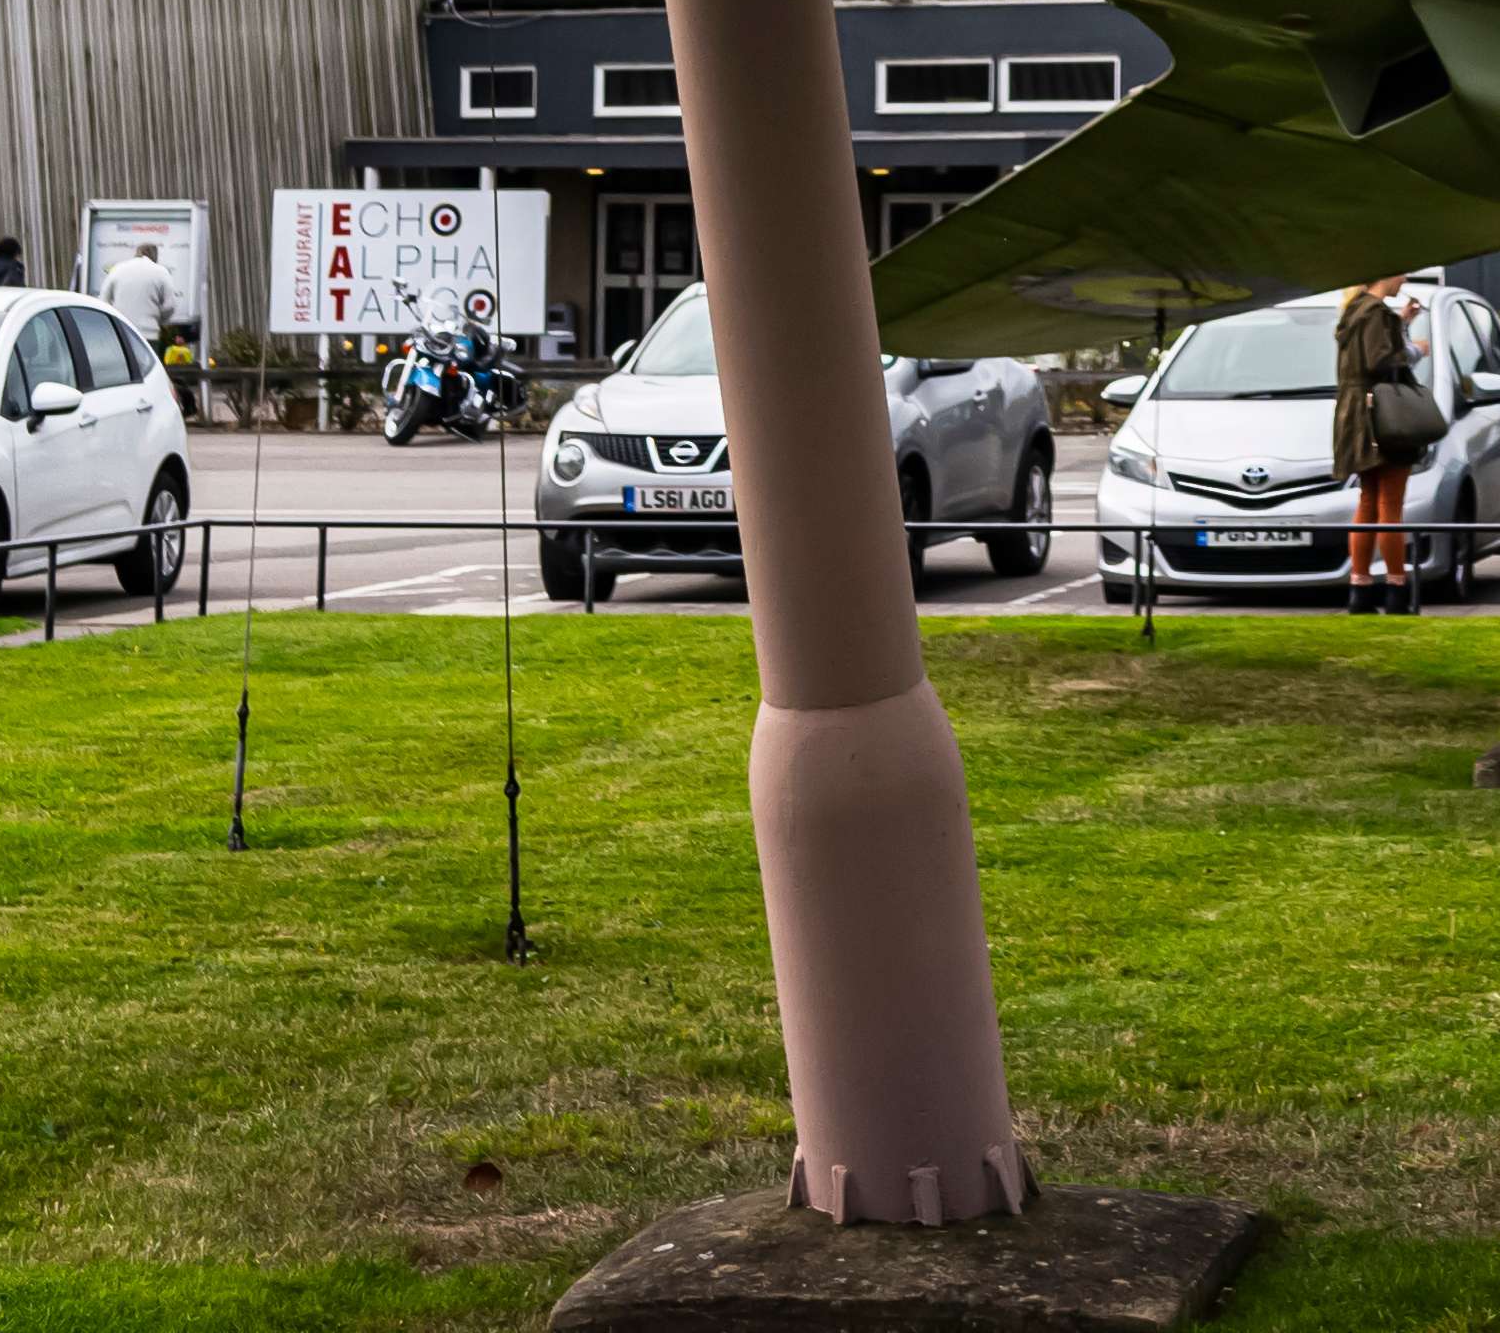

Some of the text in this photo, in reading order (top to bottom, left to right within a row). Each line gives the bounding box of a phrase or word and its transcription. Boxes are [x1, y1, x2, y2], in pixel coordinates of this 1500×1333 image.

[332, 200, 463, 238] ECHO
[293, 202, 313, 323] RESTAURANT
[328, 244, 496, 281] ALPHA
